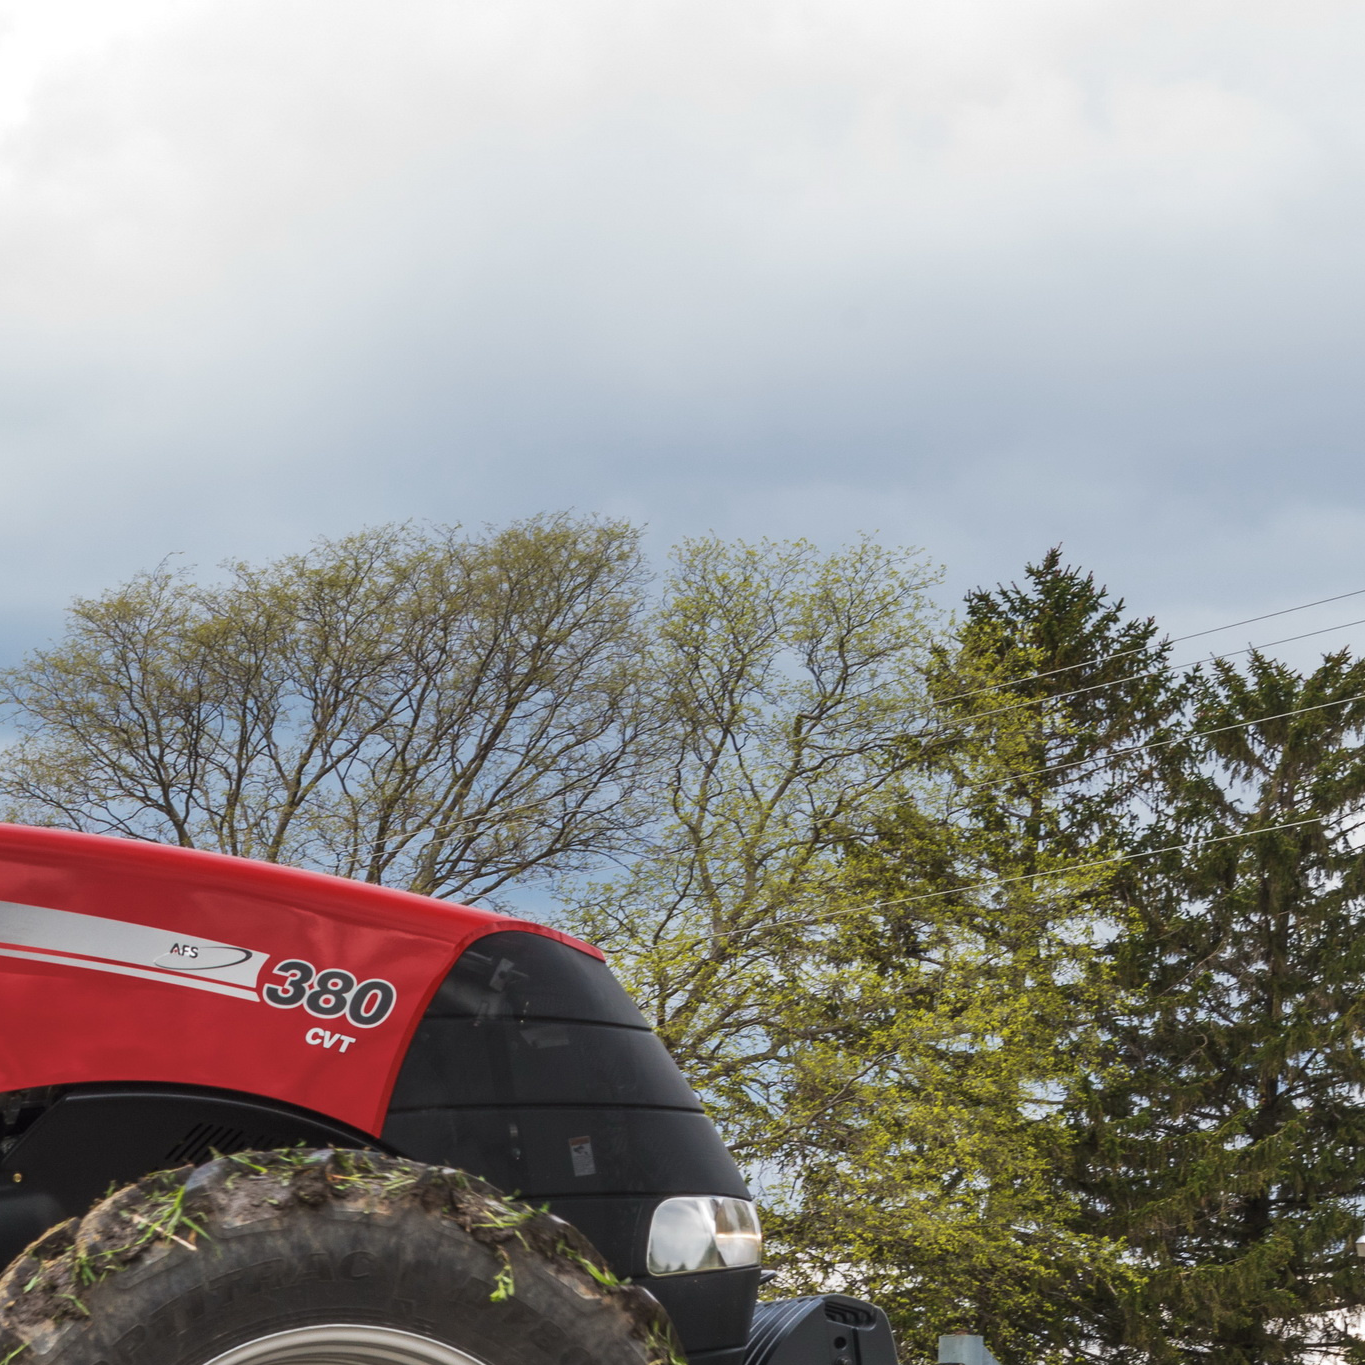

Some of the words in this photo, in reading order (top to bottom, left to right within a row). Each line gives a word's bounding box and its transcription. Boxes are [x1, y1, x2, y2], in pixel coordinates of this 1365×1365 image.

[170, 943, 199, 958] AFS
[263, 959, 397, 1028] 380
[305, 1027, 356, 1053] CVT
